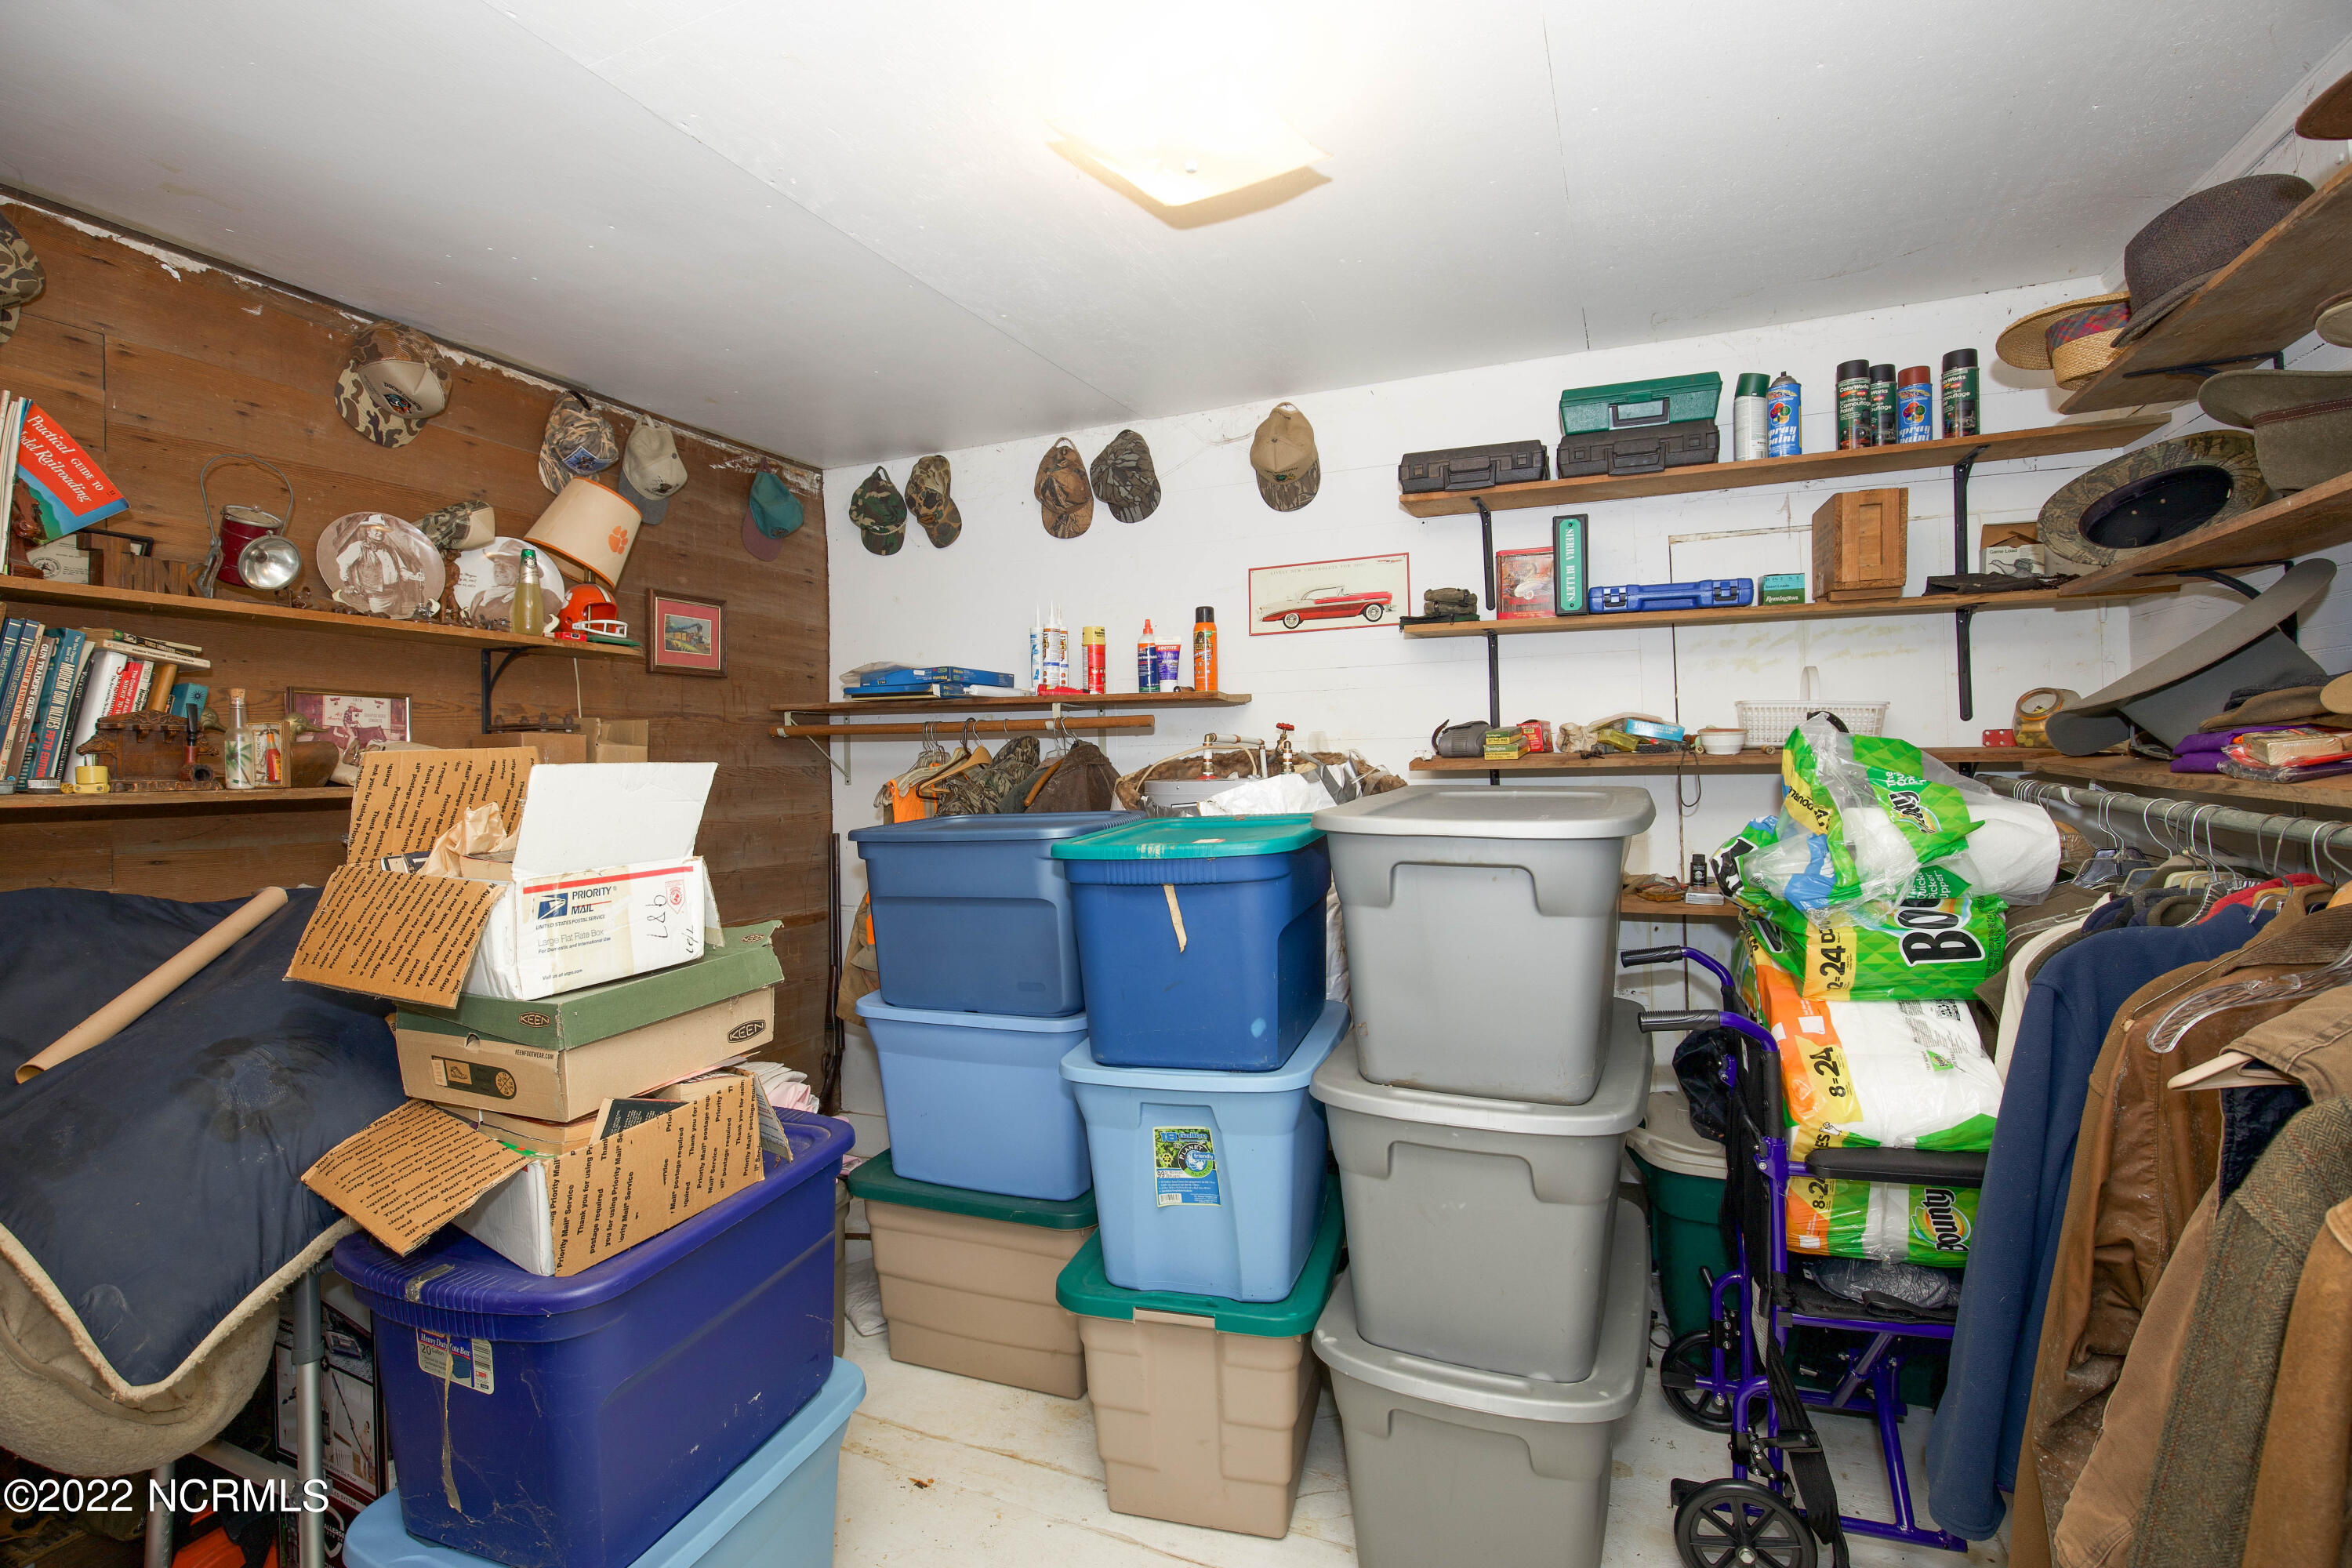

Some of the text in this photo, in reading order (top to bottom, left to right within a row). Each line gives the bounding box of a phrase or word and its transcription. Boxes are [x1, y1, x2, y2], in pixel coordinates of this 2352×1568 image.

[27, 414, 104, 491] Practical GUIDE TO
[34, 449, 92, 503] Railroading
[1565, 528, 1576, 602] SIERRA BULLETS
[3, 646, 13, 657] THE
[17, 646, 28, 666] FISHING
[38, 644, 49, 660] GUN
[13, 666, 23, 681] WITH
[29, 660, 45, 696] TRADER'S
[55, 662, 75, 691] MODERN
[12, 655, 34, 727] COMBAT HANDGUNNING
[52, 689, 68, 706] GUN
[24, 696, 35, 720] GUIDE
[47, 706, 65, 730] VALUES
[42, 729, 56, 751] FIFTH
[426, 765, 435, 785] Thank
[396, 774, 417, 829] postage required
[373, 786, 401, 857] Priority postage
[409, 810, 419, 828] using
[401, 829, 413, 853] Priority
[572, 886, 612, 900] PRIORITY
[407, 883, 456, 956] Priority Service
[571, 904, 593, 915] MAIL
[328, 896, 376, 969] Priority postage
[535, 922, 554, 931] UNITED
[572, 916, 588, 925] POSTAL
[428, 887, 491, 987] Thank you for using Priority
[538, 929, 604, 947] Large Flat Rate Box
[546, 944, 569, 953] Domestic
[577, 938, 603, 947] International
[564, 968, 583, 977] usps.com
[519, 1014, 550, 1025] KEEN
[729, 1022, 764, 1040] KEEN
[514, 1049, 554, 1060] KEENFOOTWEAR.COM
[1160, 1131, 1178, 1142] 18
[1179, 1145, 1203, 1160] PLANET
[443, 1156, 527, 1203] Thank you for using
[1191, 1165, 1211, 1177] PLASTIC
[577, 1210, 586, 1236] Thank
[585, 1156, 593, 1179] using
[556, 1236, 568, 1269] Priority
[564, 1184, 575, 1215] Service
[590, 1188, 604, 1254] postage required
[1922, 1188, 1969, 1251] Bounty
[421, 1333, 436, 1346] Heavy
[459, 1347, 470, 1356] Box
[421, 1344, 445, 1356] 20 Gallon
